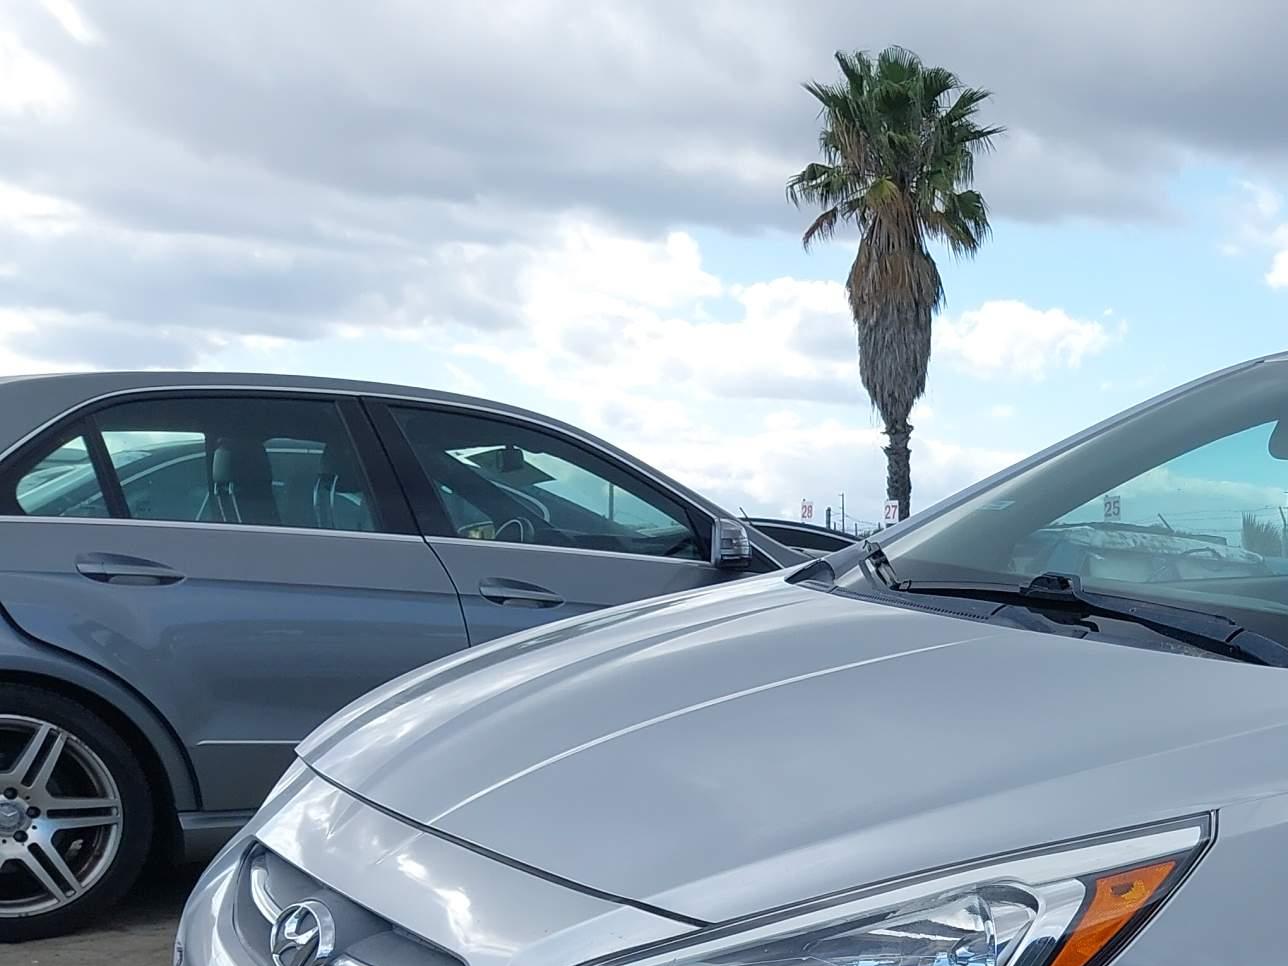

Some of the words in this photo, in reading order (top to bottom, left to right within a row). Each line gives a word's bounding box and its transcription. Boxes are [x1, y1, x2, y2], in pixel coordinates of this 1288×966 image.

[801, 504, 813, 519] 28
[884, 505, 898, 520] 27
[1104, 500, 1120, 517] 25
